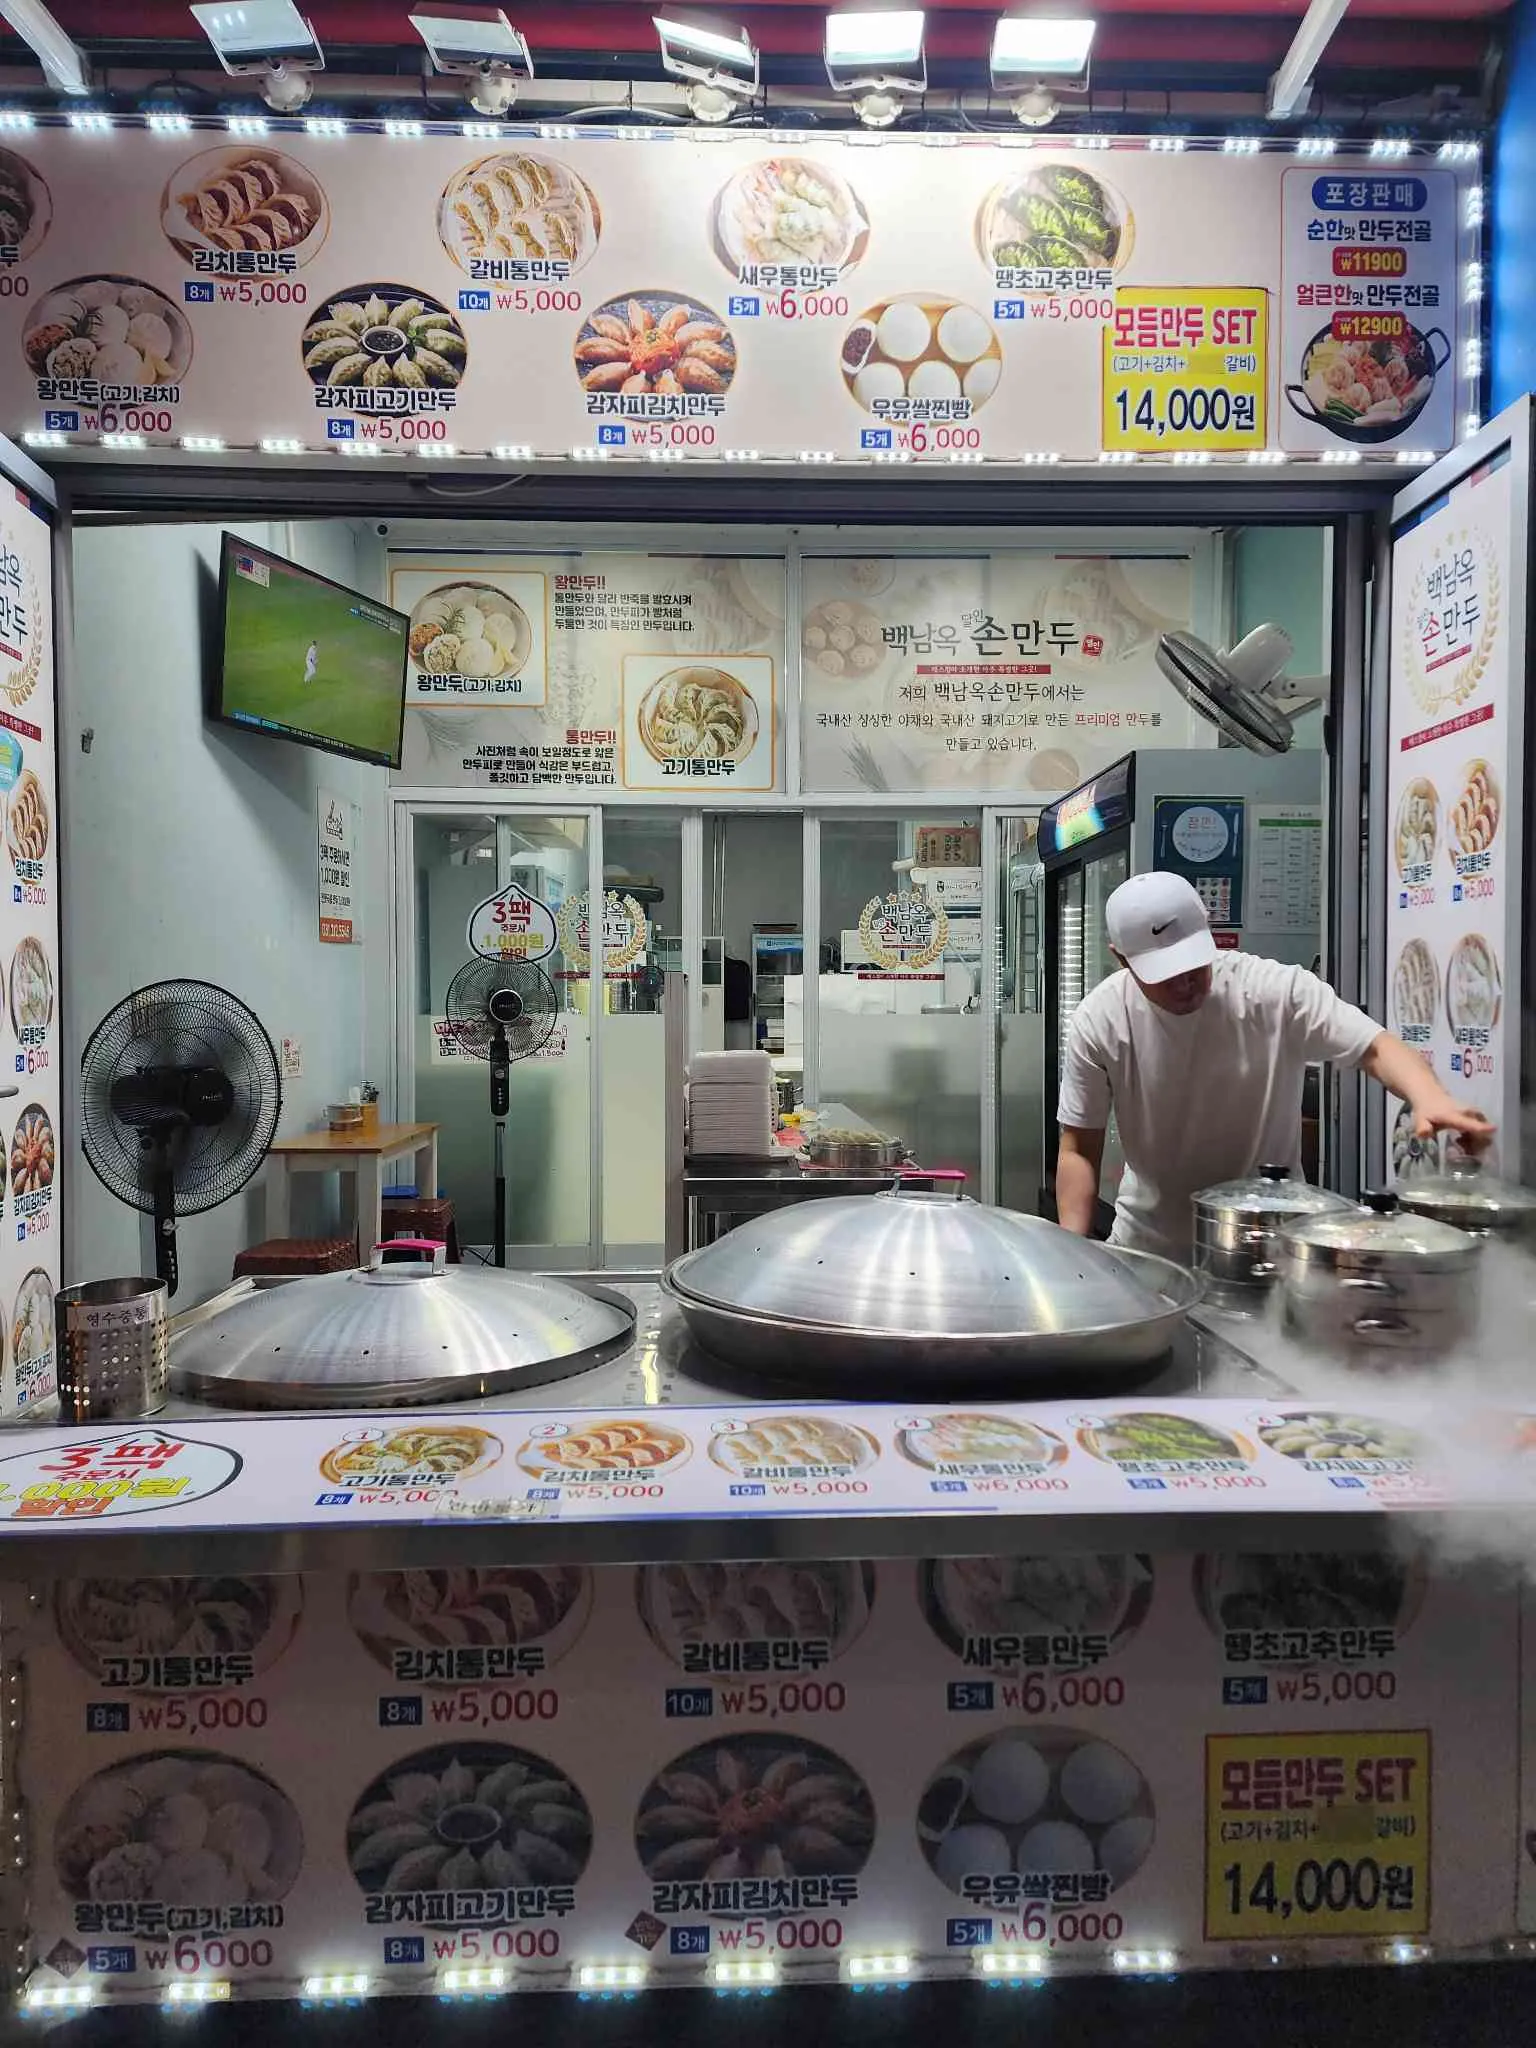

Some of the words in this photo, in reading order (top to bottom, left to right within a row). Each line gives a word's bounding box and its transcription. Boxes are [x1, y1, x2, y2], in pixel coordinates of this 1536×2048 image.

[1325, 183, 1414, 207] 포장판매
[1308, 219, 1355, 241] 순한맛
[1359, 219, 1432, 241] 만두전골
[193, 249, 297, 275] 김치통만두
[470, 259, 570, 281] 갈비통만두
[741, 265, 838, 287] 새우통만두
[996, 269, 1112, 289] 땡초고추만두
[189, 285, 211, 299] 8개
[461, 293, 488, 308] 10개
[1297, 284, 1364, 306] 얼큰한맛
[1368, 285, 1439, 306] 만두전골
[732, 299, 756, 314] 5개
[998, 302, 1020, 317] 5개
[1113, 308, 1204, 347] 모듬만두
[1213, 309, 1256, 344] SET
[1226, 355, 1256, 372] 갈비)
[315, 387, 457, 412] 감자피고기만두
[587, 394, 725, 417] 감자피김치만두
[872, 398, 972, 421] 우유쌀찐빵
[50, 413, 74, 429] 5개
[1116, 388, 1255, 436] 14,000원
[332, 423, 352, 436] 8개
[603, 428, 623, 441] 8개
[865, 431, 889, 446] 5개
[1427, 548, 1475, 604] 백남옥
[881, 622, 960, 656] 백남옥
[970, 616, 1079, 656] 손만두
[1422, 594, 1480, 656] 손만두
[935, 681, 1085, 702] 백남옥손만두에서는
[816, 714, 852, 727] 국내산
[941, 714, 974, 727] 국내산
[1045, 714, 1069, 727] 만든
[1075, 713, 1120, 727] 프리미엄
[1126, 713, 1161, 727] 만두를
[946, 738, 982, 751] 만들고
[988, 738, 1037, 752] 있습니다.
[662, 758, 735, 776] 고기통만두
[492, 901, 530, 925] 3팩
[882, 903, 928, 922] 백남옥
[501, 924, 525, 933] 주문시
[879, 922, 932, 942] 손만두
[39, 1443, 185, 1471] 3팩
[343, 1473, 457, 1487] 고기통만두
[543, 1468, 656, 1483] 김치통만두
[743, 1465, 853, 1479] 갈비통만두
[962, 1636, 1110, 1667] 새우통만두
[1224, 1629, 1396, 1661] 땡초고추만두
[394, 1644, 545, 1681] 김치통만두
[683, 1641, 829, 1672] 갈비통만두
[101, 1655, 254, 1687] 고기통만두
[387, 1701, 417, 1721] 8개
[1221, 1758, 1344, 1811] 모듬만두
[1355, 1758, 1417, 1802] SET
[653, 1878, 859, 1914] 감자피김치만두
[963, 1873, 1111, 1905] 우유쌀찐빵
[1223, 1859, 1416, 1920] 14,000원
[365, 1886, 576, 1923] 감자피고기만두
[952, 1923, 986, 1943] 5개
[95, 1951, 129, 1969] 5개
[391, 1941, 420, 1958] 8개
